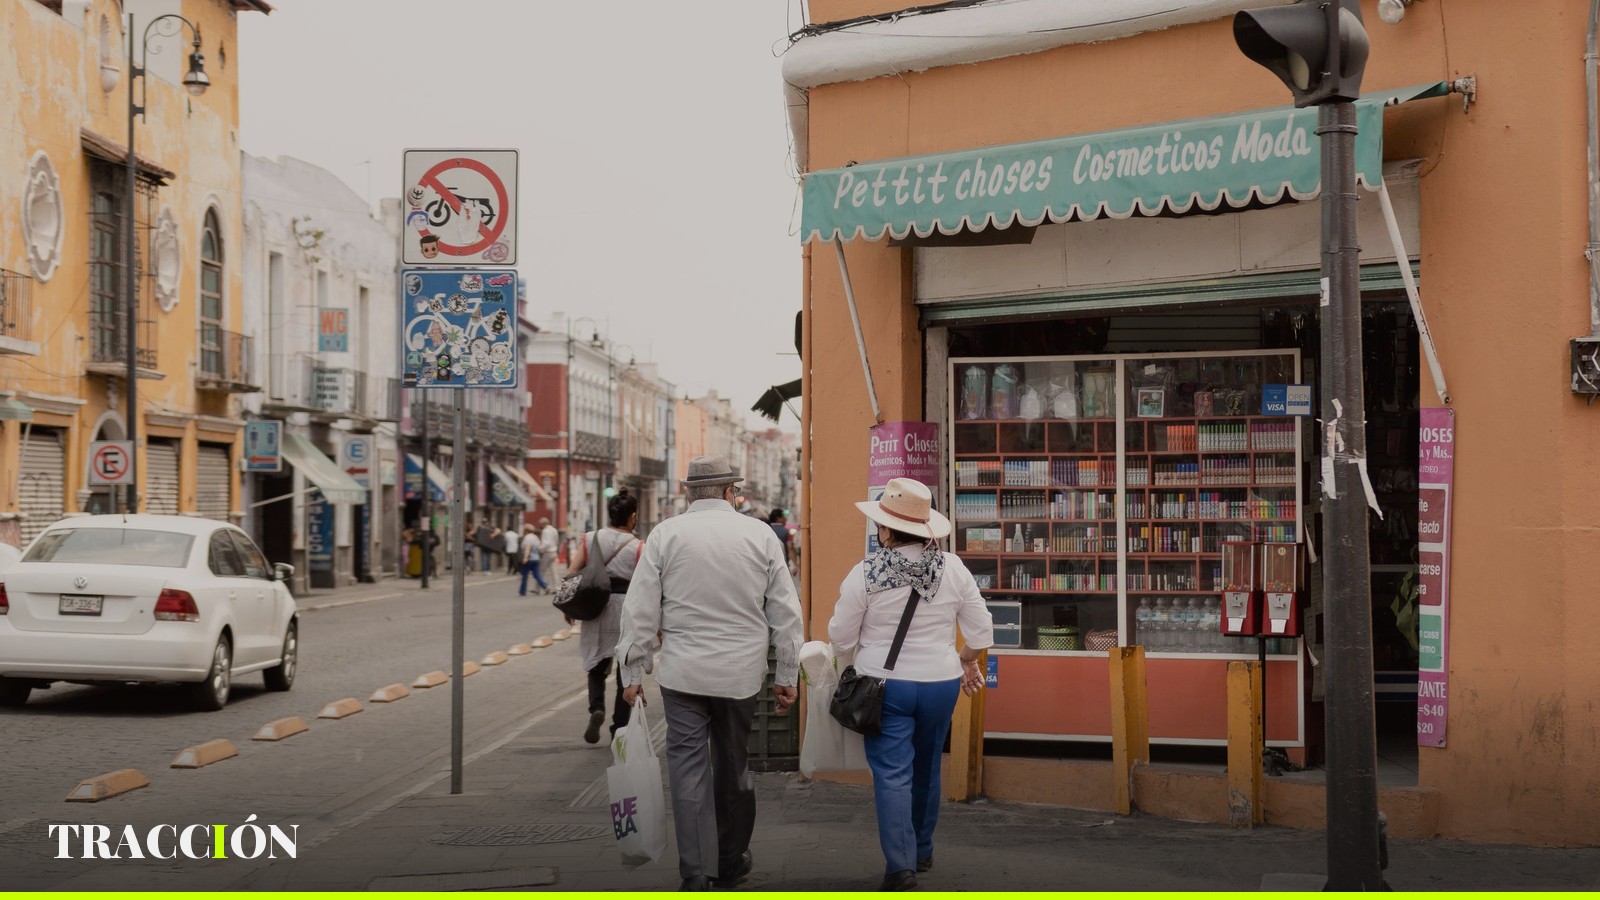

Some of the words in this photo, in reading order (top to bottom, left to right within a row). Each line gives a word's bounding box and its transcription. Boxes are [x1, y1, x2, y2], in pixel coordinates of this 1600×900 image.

[834, 162, 949, 209] Pettit
[956, 155, 1053, 200] choses
[1073, 130, 1224, 184] Cosmeticos
[1231, 112, 1312, 165] Moda
[319, 310, 348, 334] WC
[1266, 403, 1285, 411] VISA
[350, 443, 363, 458] E
[871, 433, 899, 454] PETIT
[904, 432, 939, 453] CHOSES
[102, 451, 119, 474] E
[1426, 449, 1431, 461] y
[1423, 631, 1440, 640] casa
[1419, 644, 1436, 654] ermo
[610, 796, 638, 819] PUE
[613, 816, 638, 841] BLA
